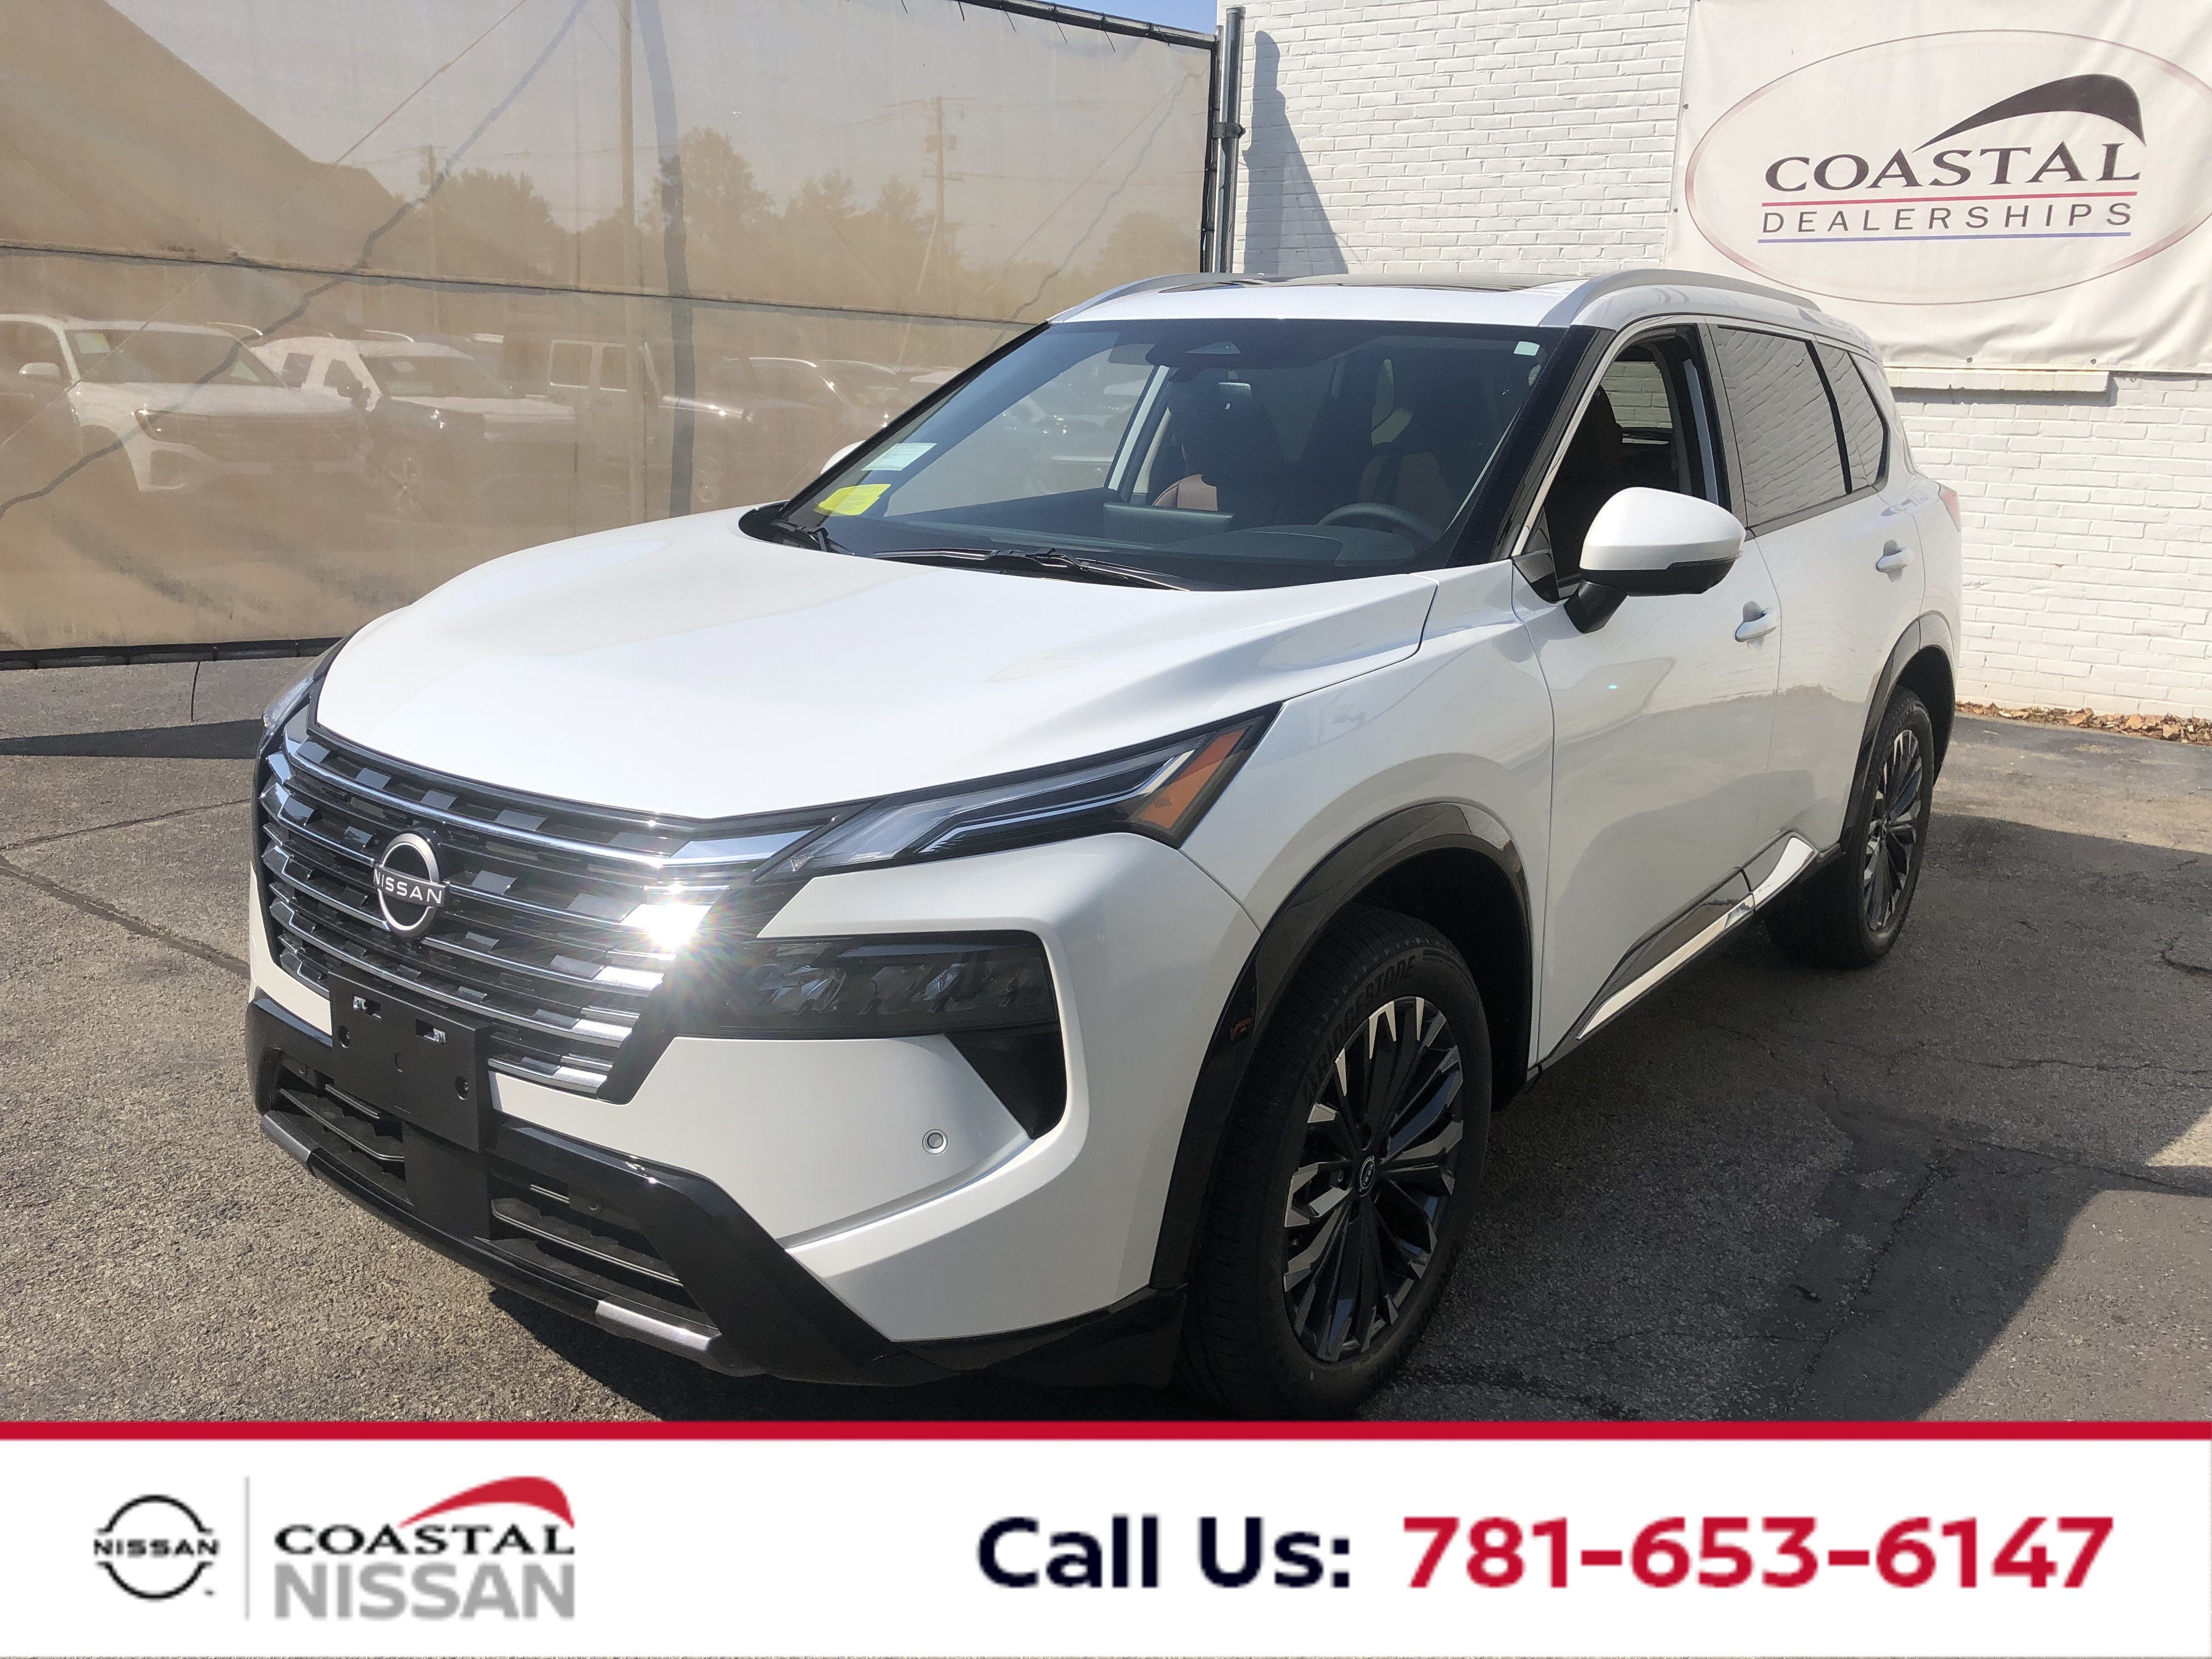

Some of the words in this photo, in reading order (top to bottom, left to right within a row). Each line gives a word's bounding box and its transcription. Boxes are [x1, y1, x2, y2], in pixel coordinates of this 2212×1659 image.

[1764, 140, 2142, 193] COASTAL
[1762, 202, 2132, 234] DEALERSHIPS
[373, 868, 443, 904] NISSAN
